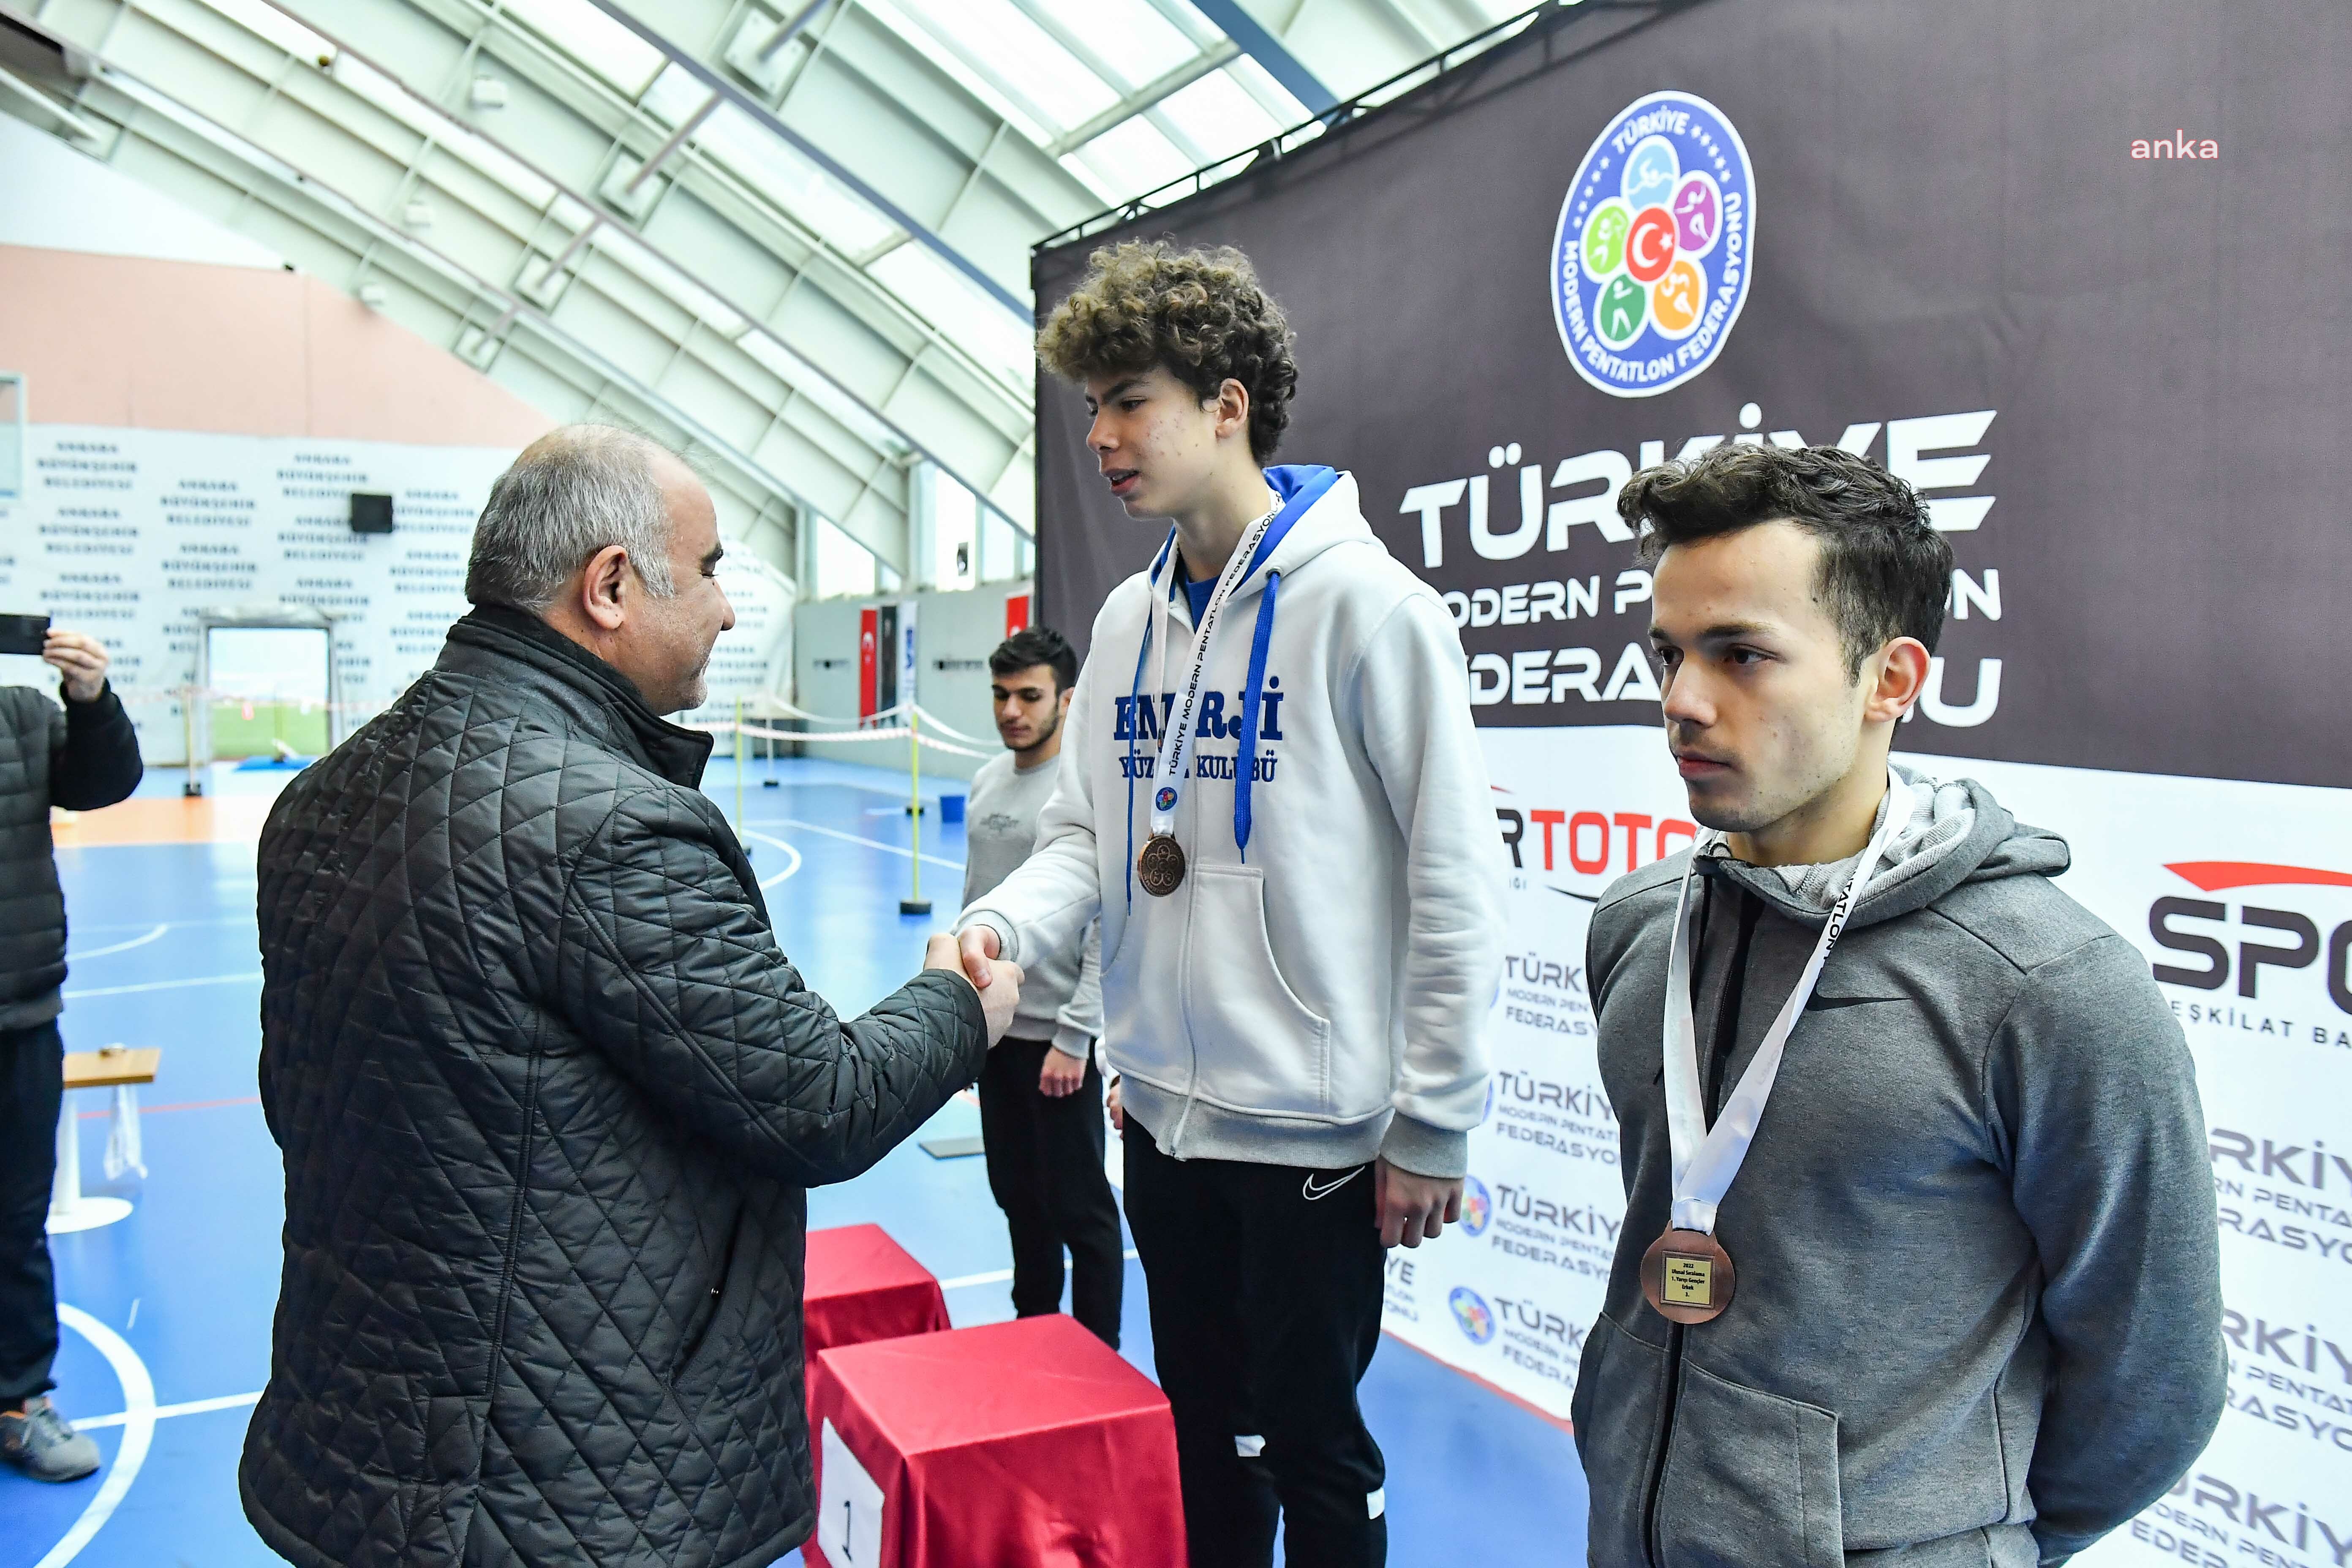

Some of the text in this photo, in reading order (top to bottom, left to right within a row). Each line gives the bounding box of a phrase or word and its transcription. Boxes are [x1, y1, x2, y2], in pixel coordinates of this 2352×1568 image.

[1611, 104, 1690, 155] TÜRKİYE
[1562, 191, 1743, 383] MODERN PENTATLON FEDERASYONU
[1441, 574, 1600, 628] ODERN
[1169, 507, 1278, 776] TÜRKİYE MODERN PENTATLON FEDERASYONU
[1119, 749, 1278, 782] YÜZ KULBÜ
[1826, 878, 1853, 950] TATLON
[1505, 951, 1582, 993] TÜRK
[2171, 1000, 2294, 1037] EŞKİLAT
[1500, 1070, 1612, 1120] TÜRKİY
[1497, 1122, 1620, 1165] FEDERASYO
[1497, 1184, 1621, 1241] TÜRKİY
[1494, 1297, 1583, 1351] TÜRK
